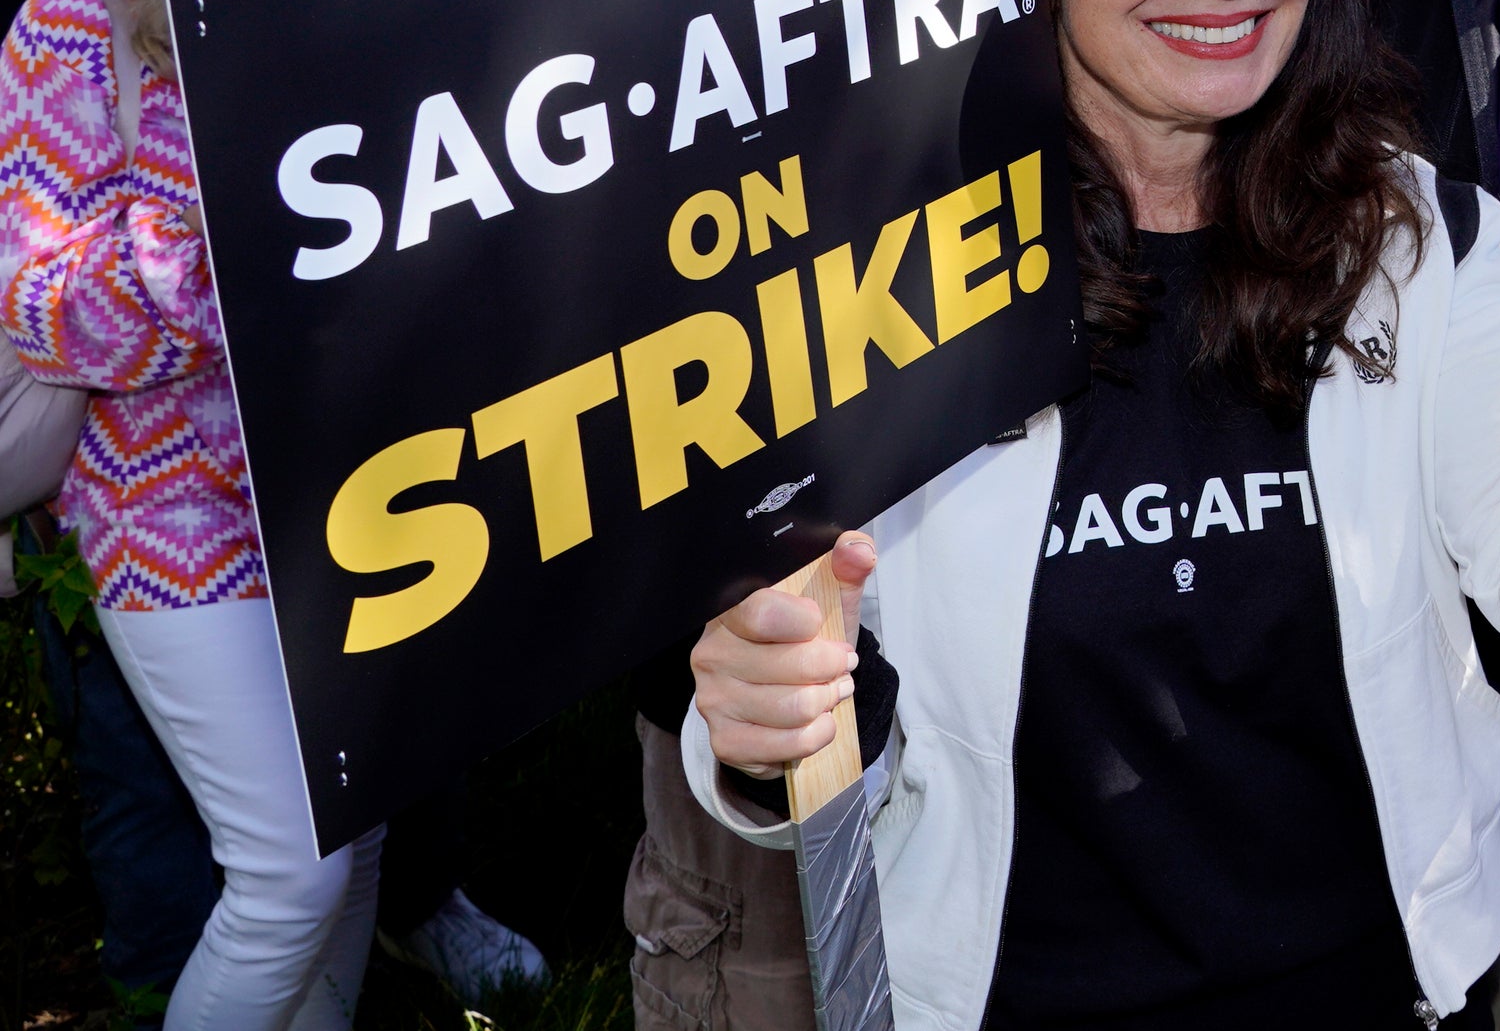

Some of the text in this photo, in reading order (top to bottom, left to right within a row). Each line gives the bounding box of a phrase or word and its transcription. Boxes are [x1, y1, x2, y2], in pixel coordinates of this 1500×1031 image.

[667, 155, 811, 281] ON
[326, 149, 1051, 654] STRIKE!
[802, 473, 815, 487] 201
